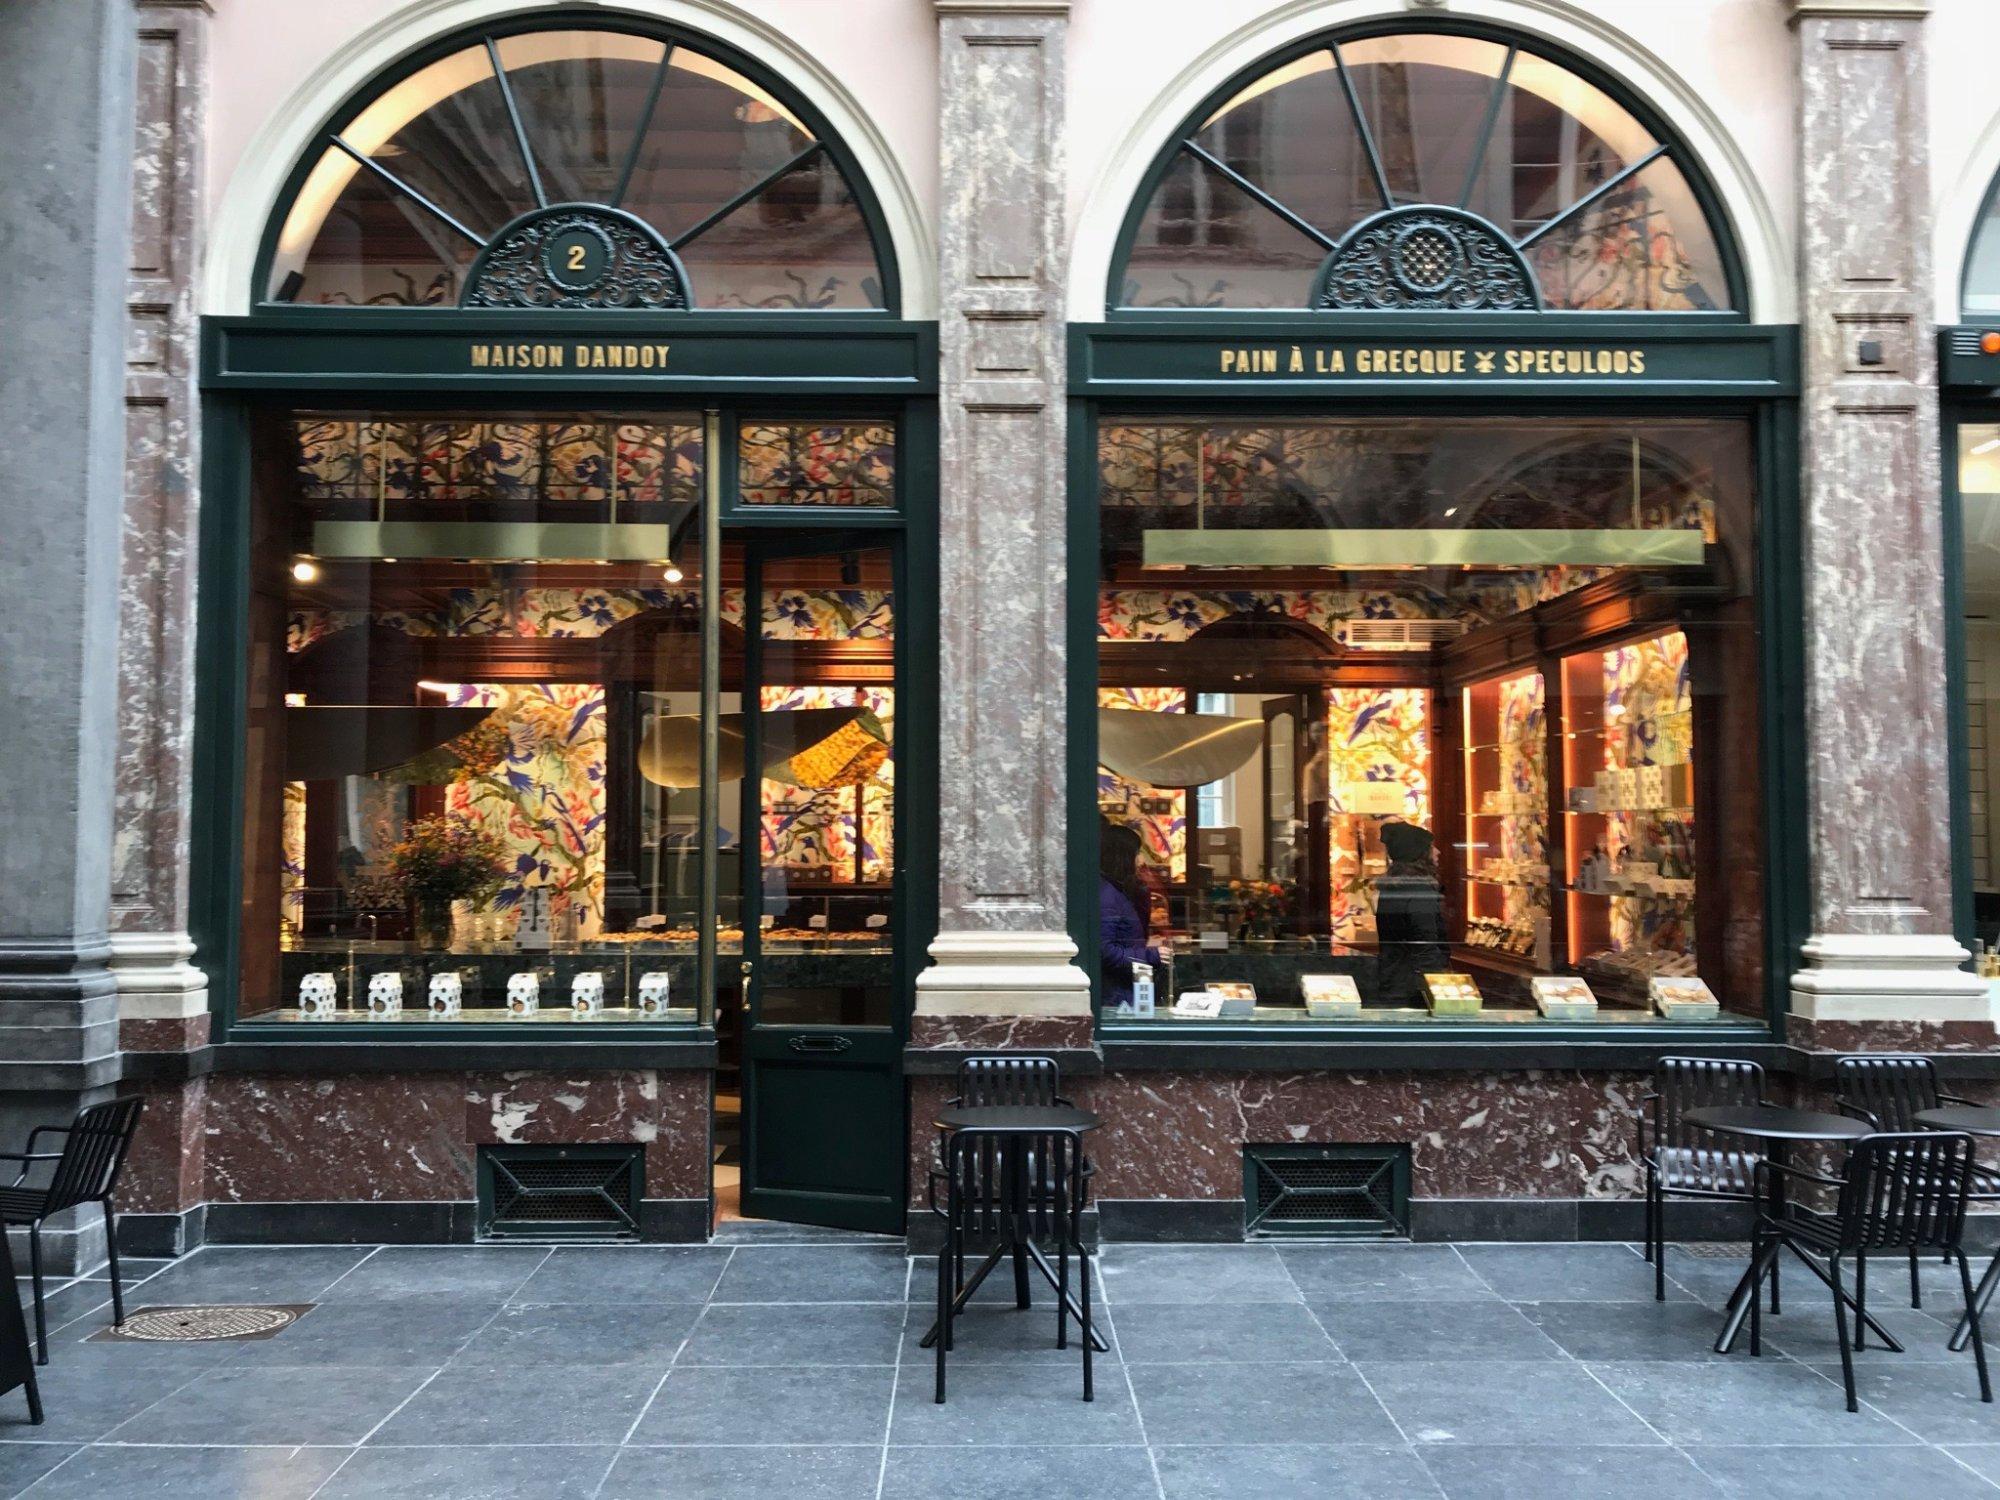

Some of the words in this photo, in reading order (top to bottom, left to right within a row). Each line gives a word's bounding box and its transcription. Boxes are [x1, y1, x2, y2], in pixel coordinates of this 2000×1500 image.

[567, 245, 586, 270] 2
[470, 344, 564, 368] MAISON
[575, 345, 670, 368] DANDOY
[1220, 349, 1278, 373] PAIN
[1288, 345, 1305, 373] À
[1315, 349, 1346, 373] LA
[1356, 348, 1467, 374] GRECQUE
[1504, 349, 1646, 374] SPECULOOS
